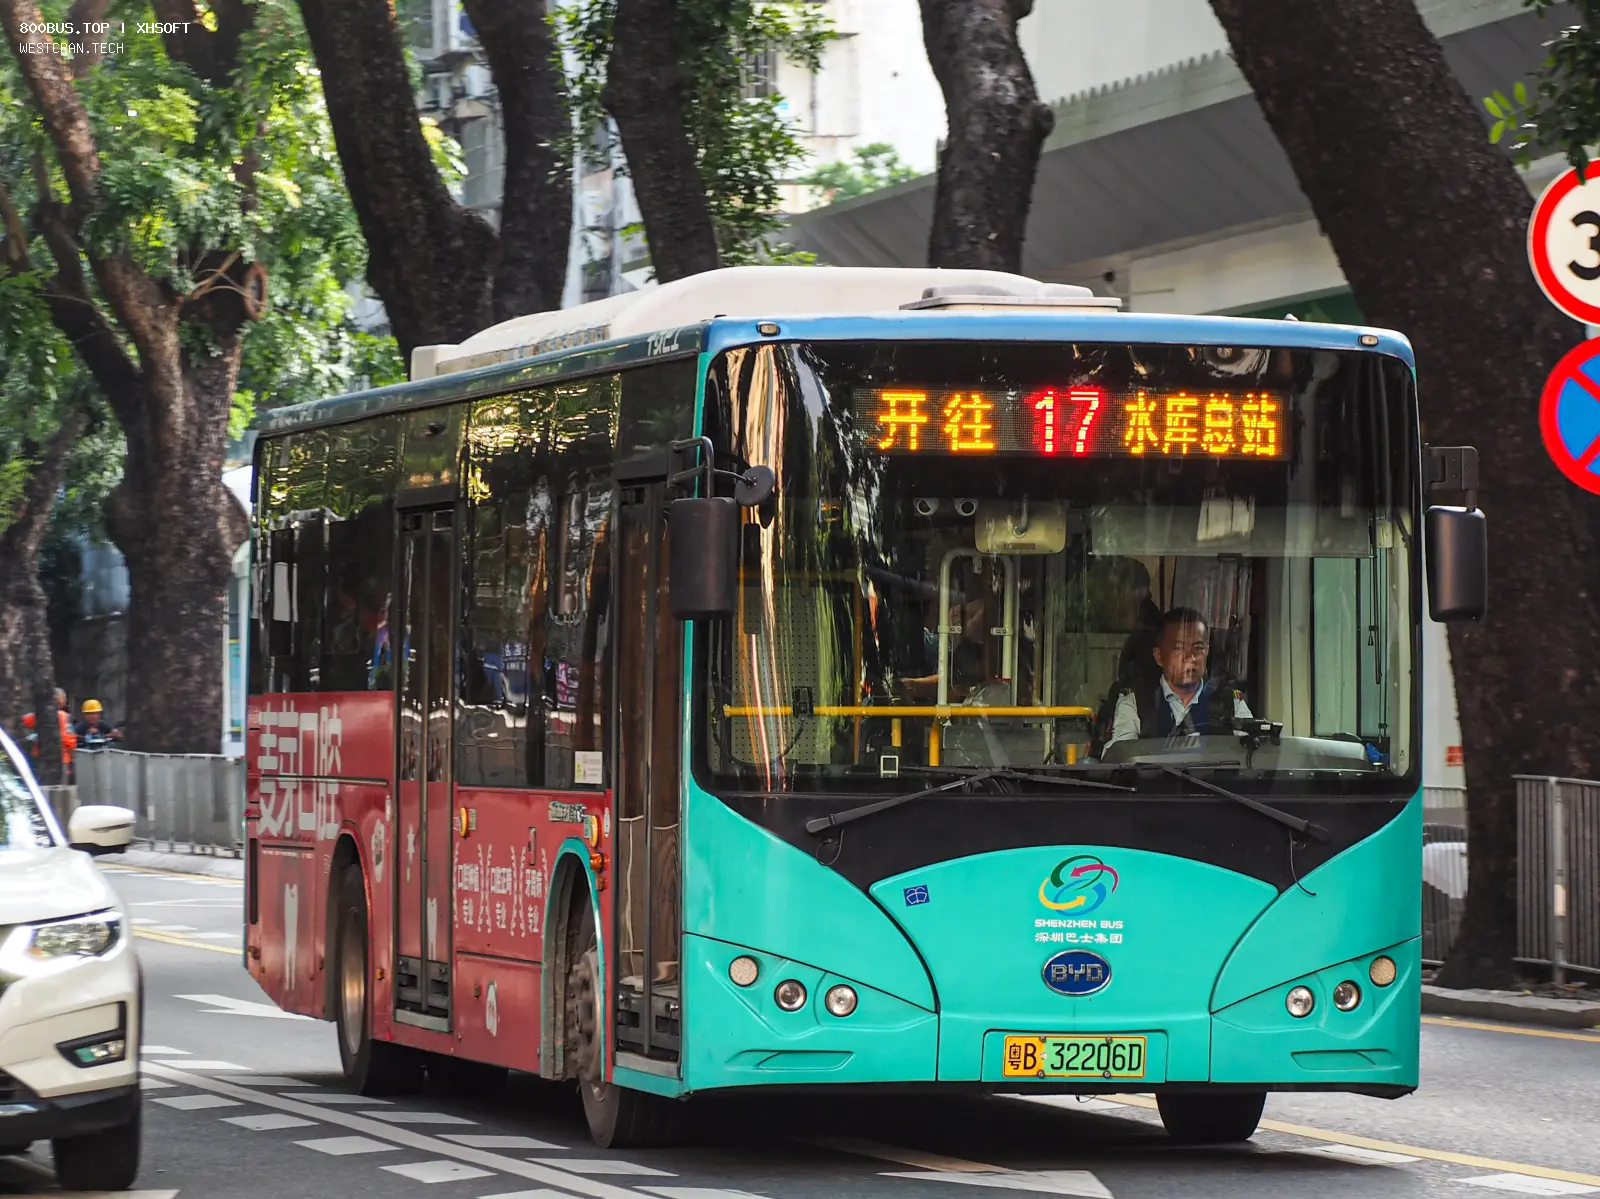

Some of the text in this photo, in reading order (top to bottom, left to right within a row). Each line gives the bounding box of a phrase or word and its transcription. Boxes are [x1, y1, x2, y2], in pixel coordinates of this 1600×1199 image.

[879, 390, 1276, 456] 开往 17 水库总站
[1034, 918, 1124, 930] SHENZHEN BUS
[1034, 932, 1123, 944] 深圳巴士集团
[1051, 963, 1103, 983] BYD
[1050, 1042, 1143, 1072] 32206D
